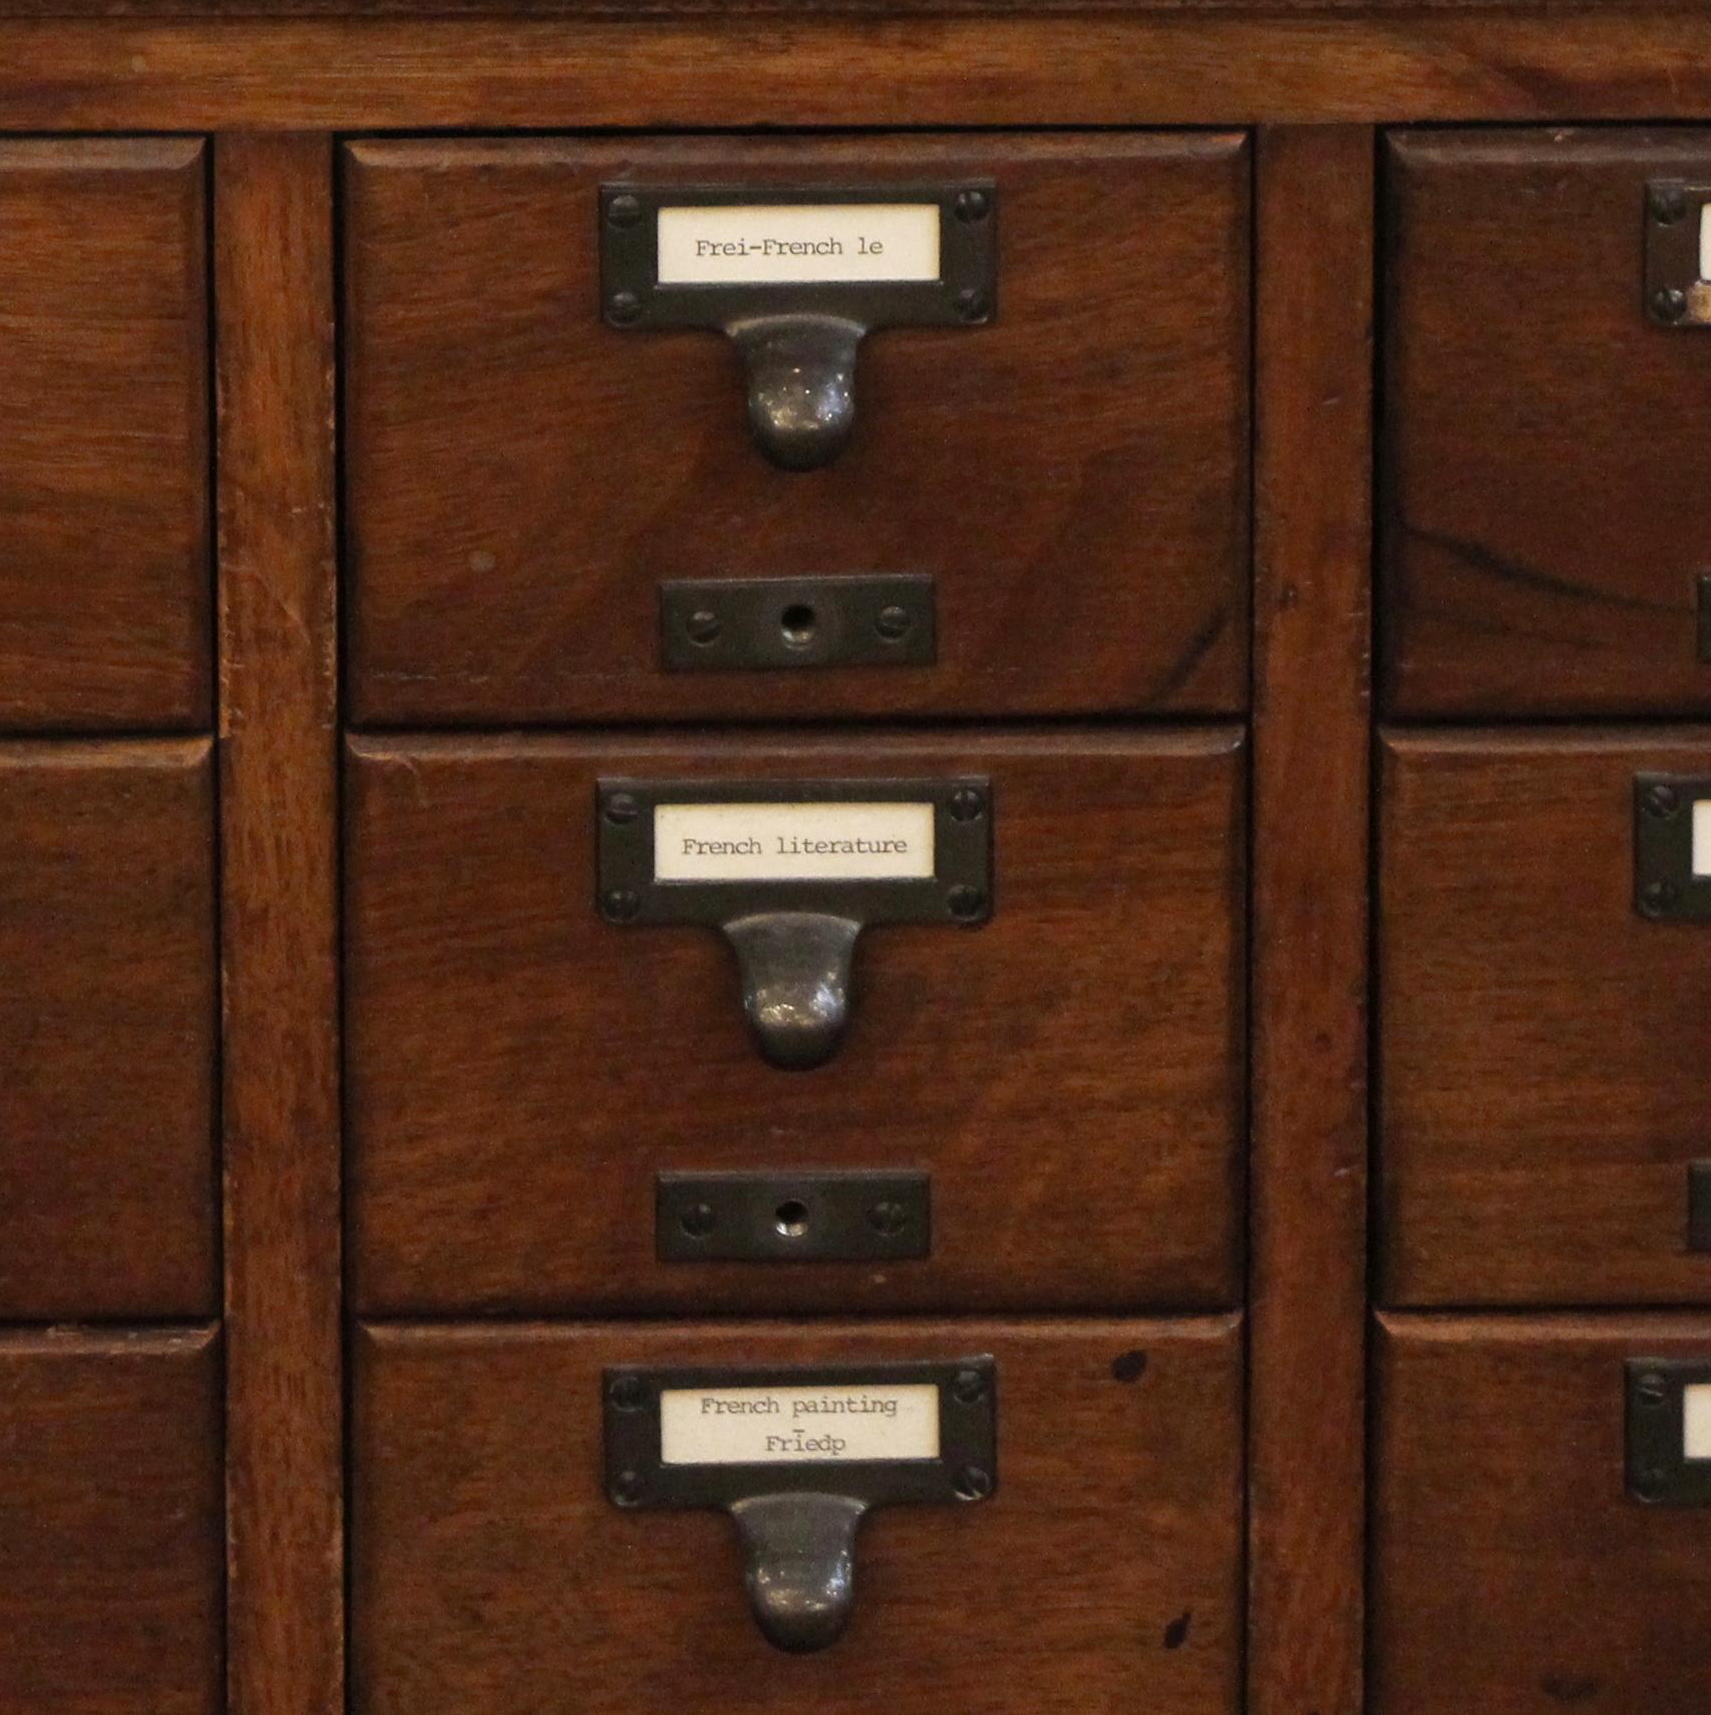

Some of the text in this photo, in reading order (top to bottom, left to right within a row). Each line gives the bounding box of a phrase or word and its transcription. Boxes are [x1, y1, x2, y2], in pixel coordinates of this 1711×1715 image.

[695, 237, 884, 258] Frei-French le
[681, 836, 908, 856] French literature
[700, 1396, 898, 1418] French painting
[765, 1434, 847, 1456] Friedp
